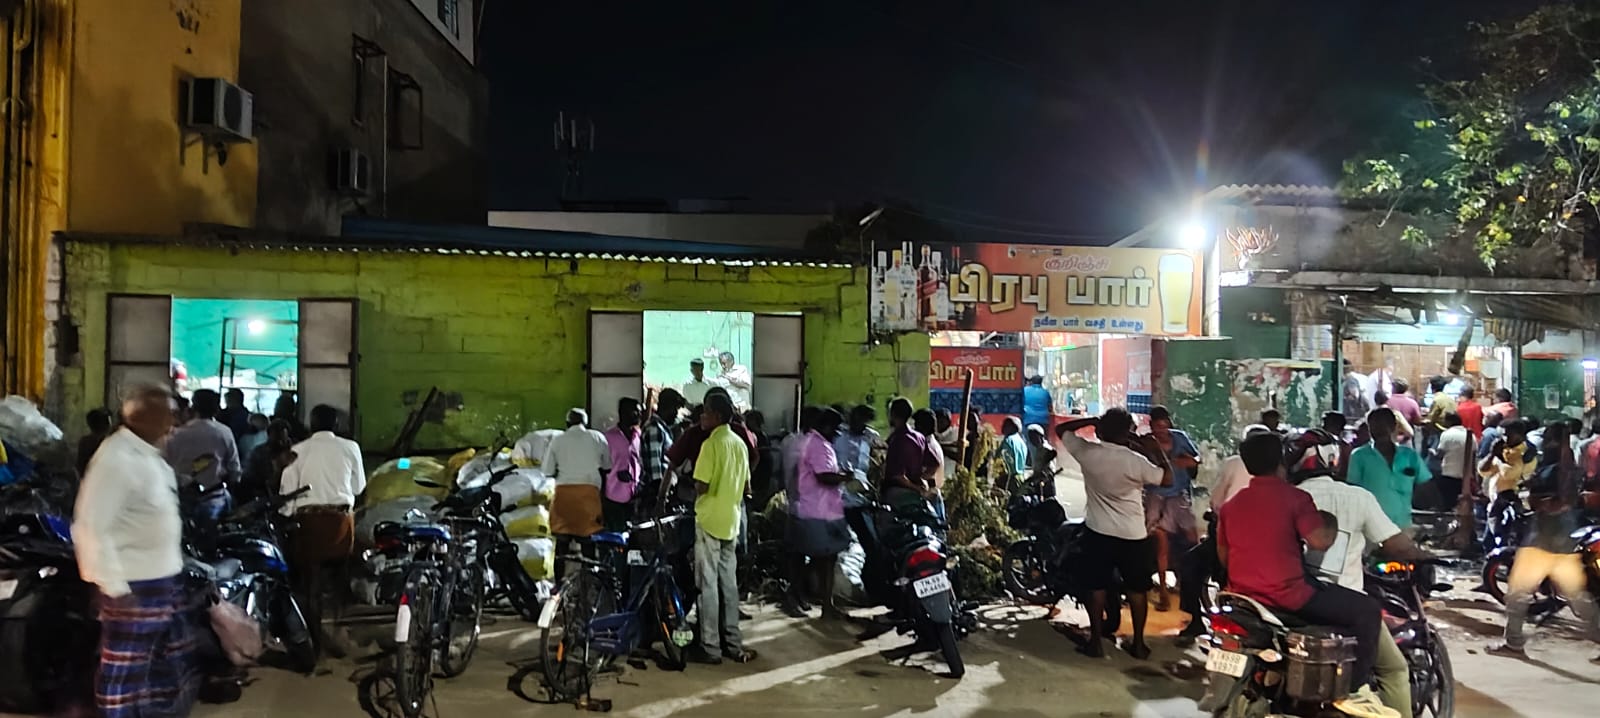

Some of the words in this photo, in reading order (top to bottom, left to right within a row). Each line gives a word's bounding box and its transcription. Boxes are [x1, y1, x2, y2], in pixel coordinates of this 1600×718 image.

[949, 262, 1048, 313] பிரபு
[1067, 266, 1154, 307] பார்
[1063, 317, 1079, 327] பார்
[1085, 318, 1106, 329] வசதி
[978, 362, 1017, 381] பார்
